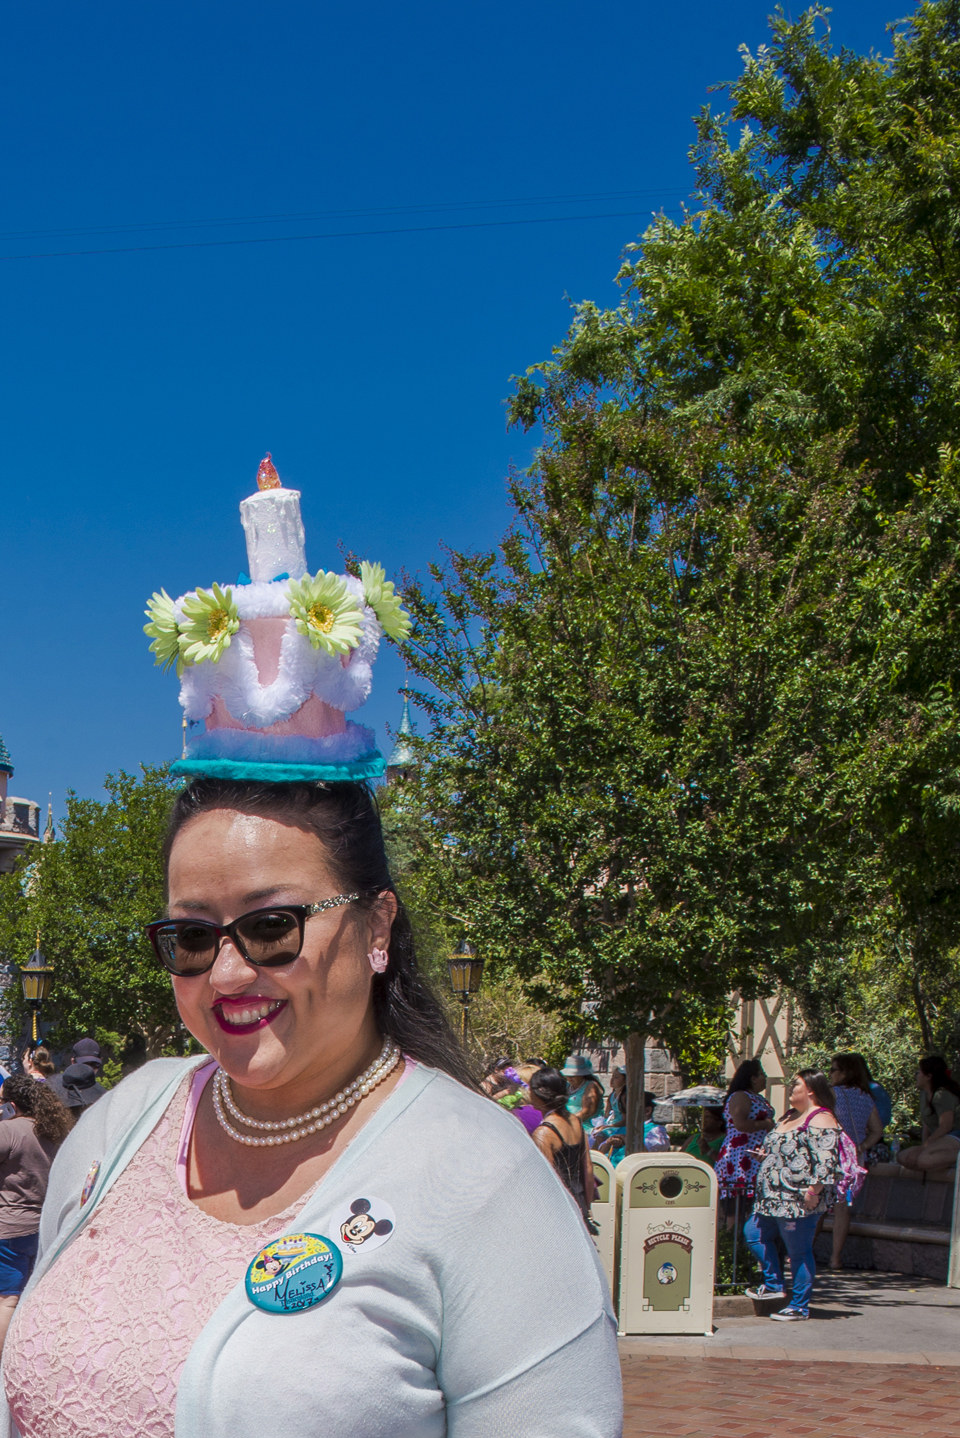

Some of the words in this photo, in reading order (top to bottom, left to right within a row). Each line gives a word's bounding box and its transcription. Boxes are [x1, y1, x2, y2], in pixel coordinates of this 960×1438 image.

[647, 1233, 670, 1246] RECYCLE
[671, 1233, 690, 1246] PLEASE
[251, 1276, 284, 1295] Happy
[285, 1252, 334, 1280] Birthday!
